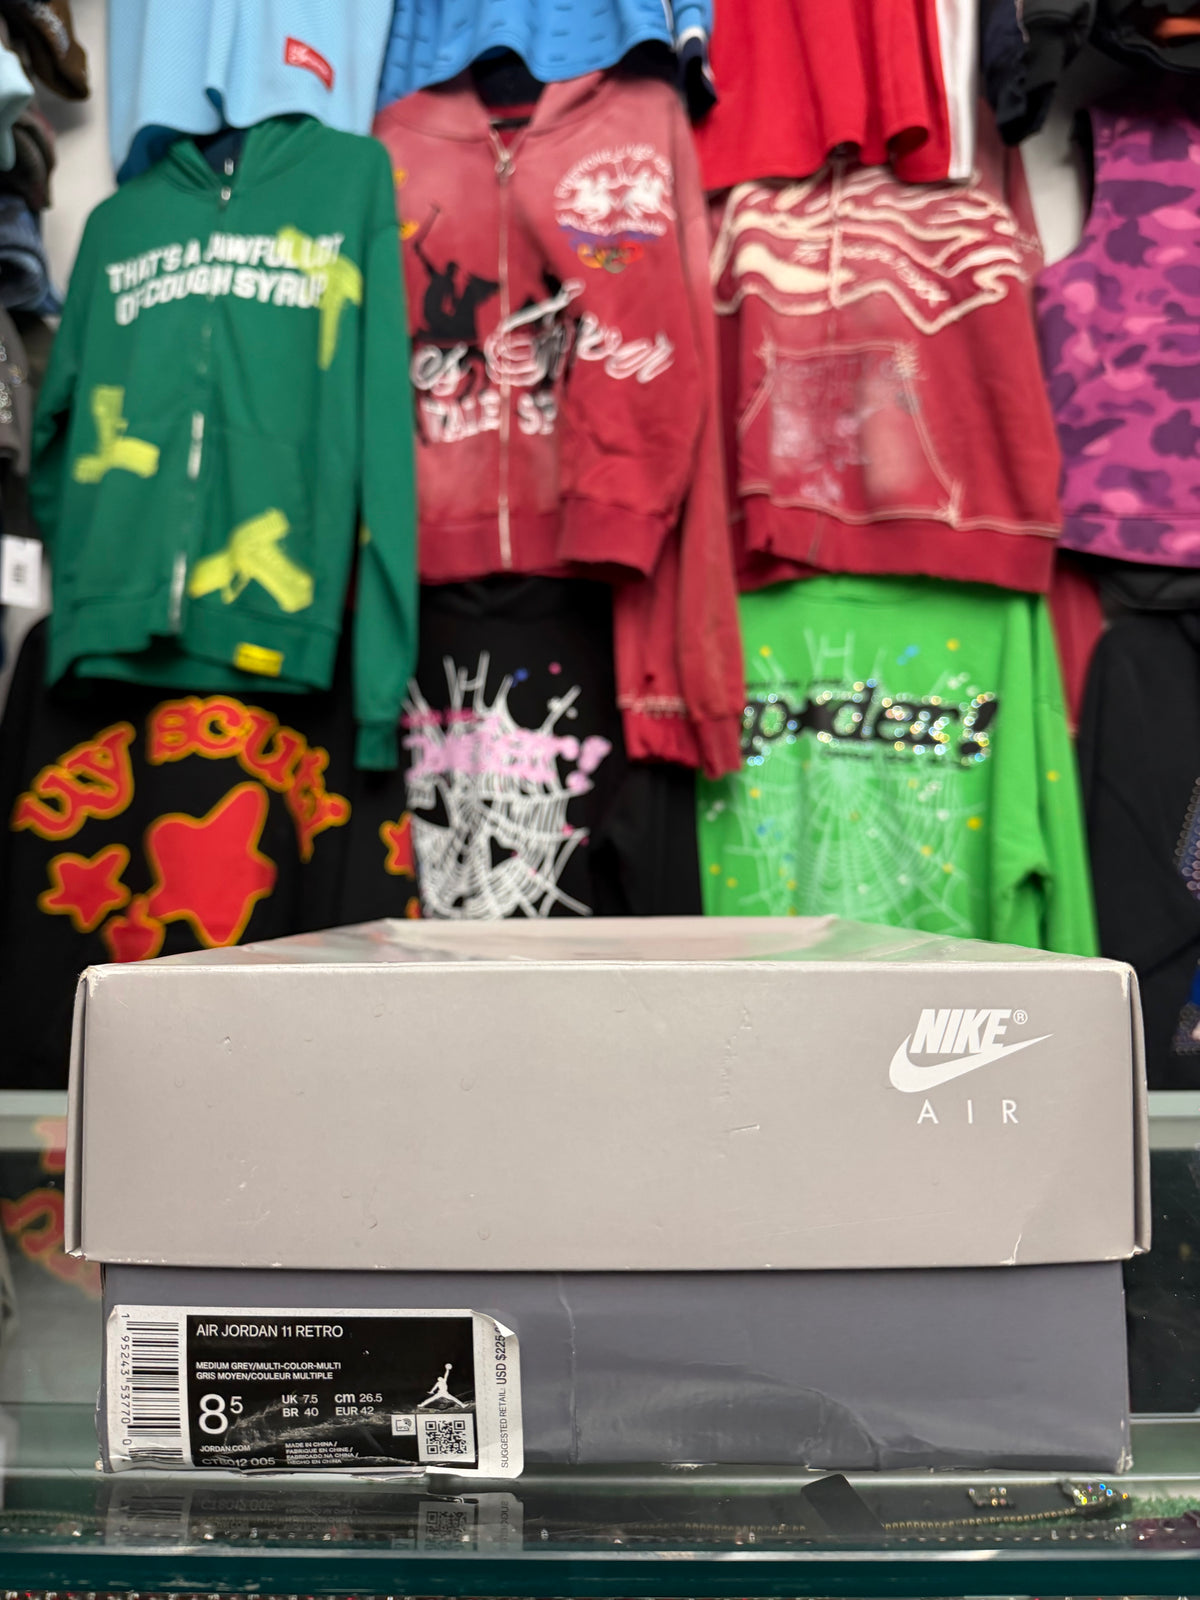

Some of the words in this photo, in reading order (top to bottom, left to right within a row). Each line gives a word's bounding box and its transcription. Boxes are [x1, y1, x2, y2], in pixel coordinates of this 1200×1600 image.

[106, 243, 184, 293] THAT'S
[182, 239, 201, 268] A
[909, 1008, 1012, 1054] NIKE
[917, 1099, 1019, 1125] AIR
[196, 1324, 219, 1337] AIR
[221, 1324, 277, 1338] JORDAN
[281, 1325, 292, 1337] 11
[295, 1325, 344, 1338] RETRO
[120, 1335, 131, 1379] 95243
[196, 1362, 230, 1370] MEDIUM
[231, 1362, 341, 1371] GREY/MULTI-COLOR-MULTI
[495, 1362, 507, 1385] USD
[196, 1371, 216, 1380] GRIS
[218, 1371, 292, 1381] MOYEN/COULEUR
[293, 1371, 334, 1380] MULTIPLE
[120, 1385, 132, 1424] 53770
[281, 1394, 298, 1404] UK
[302, 1394, 319, 1404] 7.5
[334, 1393, 356, 1404] cm
[359, 1393, 383, 1403] 26.5
[282, 1407, 299, 1417] BR
[303, 1407, 319, 1417] 40
[335, 1406, 359, 1416] EUR
[360, 1406, 375, 1415] 42
[122, 1438, 133, 1446] 0
[199, 1445, 251, 1453] JORDAN.COM
[499, 1418, 509, 1469] SUGGESTED
[250, 1457, 276, 1467] 005
